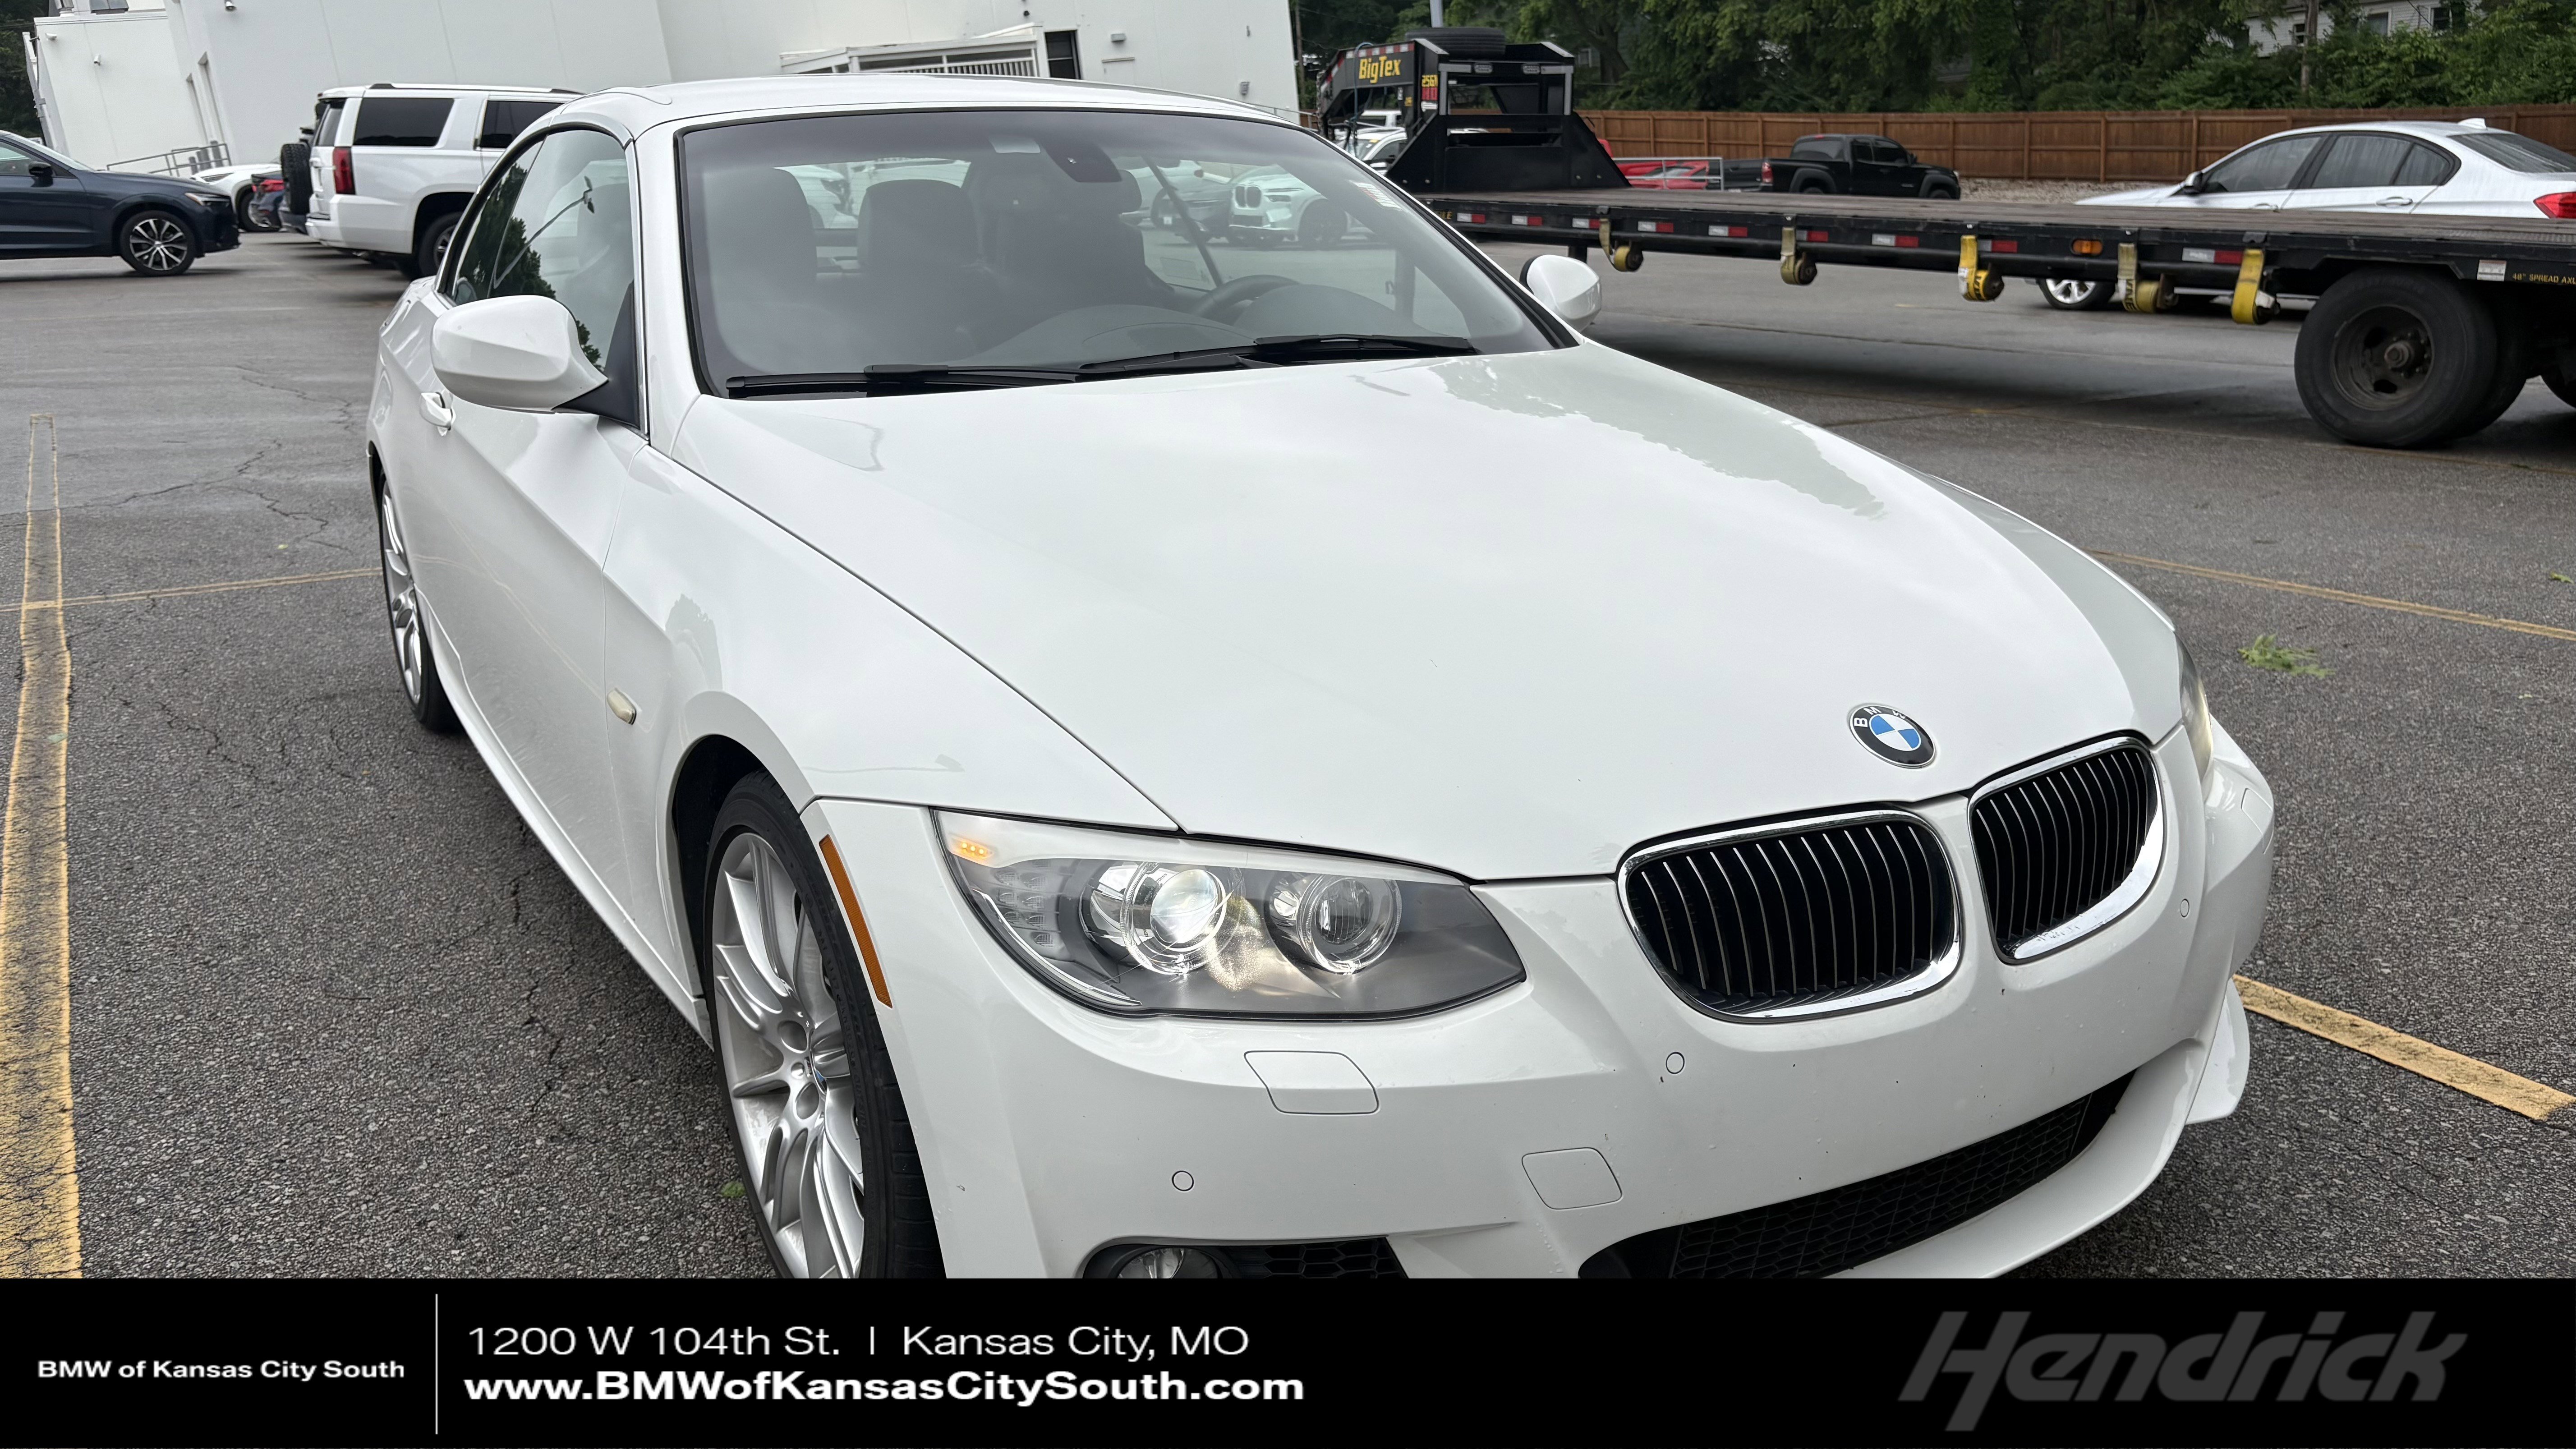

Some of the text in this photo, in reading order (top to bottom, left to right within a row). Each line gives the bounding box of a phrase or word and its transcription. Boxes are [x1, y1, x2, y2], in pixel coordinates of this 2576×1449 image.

[1358, 55, 1401, 84] BigTex
[2529, 274, 2559, 283] SPREAD
[1854, 706, 1906, 727] BMW
